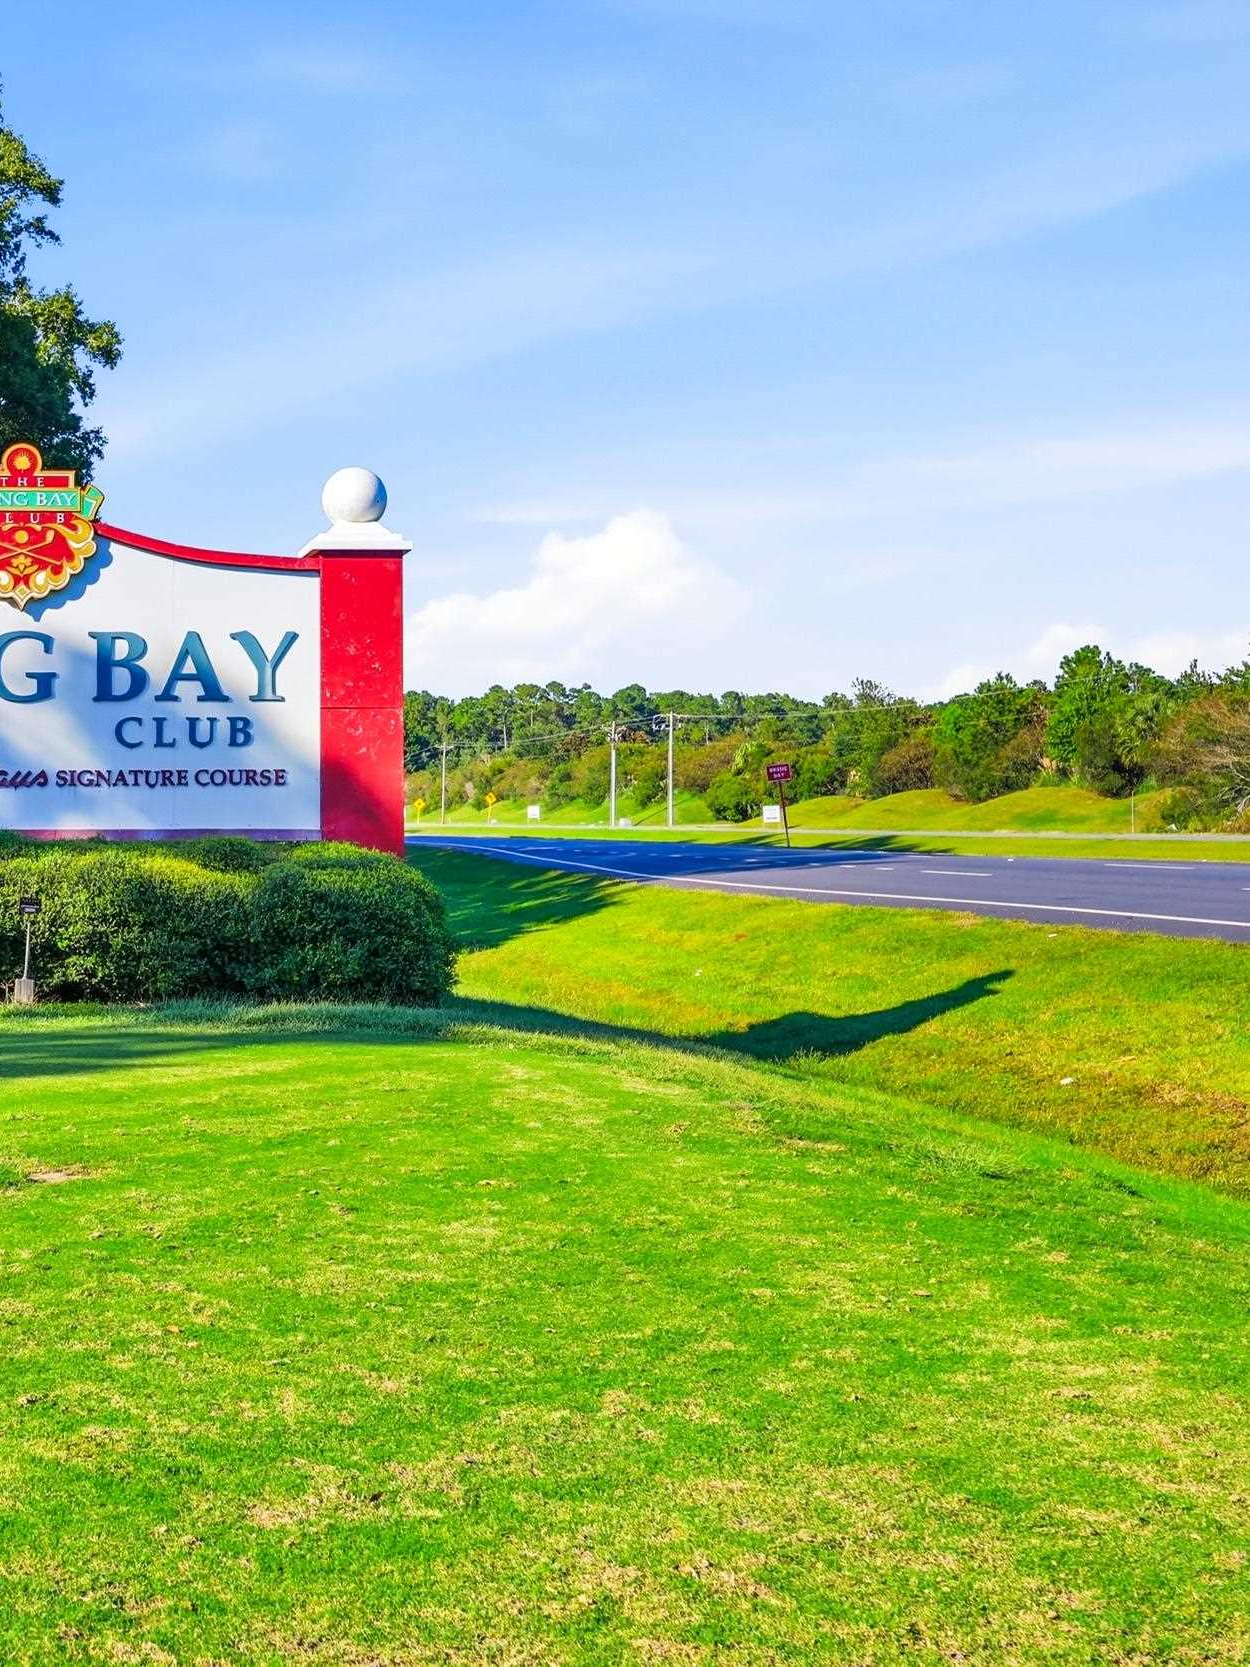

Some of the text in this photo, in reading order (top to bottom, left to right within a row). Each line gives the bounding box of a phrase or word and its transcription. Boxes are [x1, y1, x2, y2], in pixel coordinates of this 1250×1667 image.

[0, 476, 45, 487] THE
[36, 491, 77, 506] BAY
[88, 631, 299, 703] BAY
[114, 716, 254, 749] CLUB
[55, 769, 189, 788] SIGNATURE
[194, 768, 287, 787] COURSE
